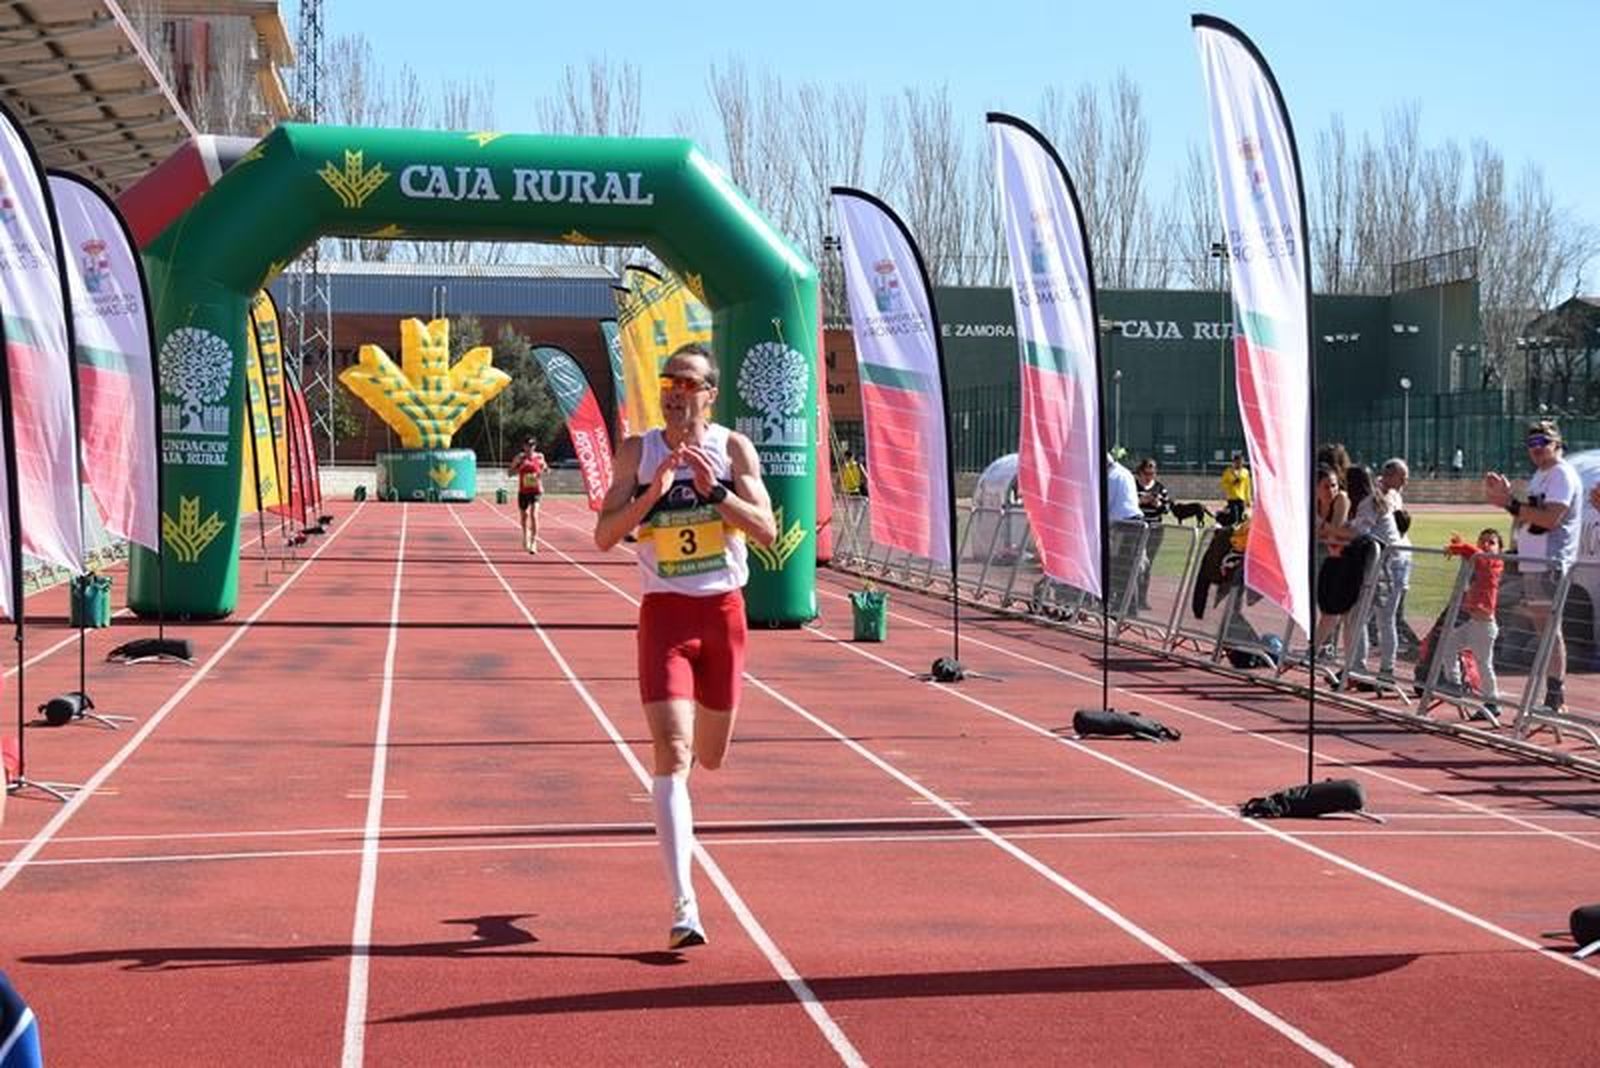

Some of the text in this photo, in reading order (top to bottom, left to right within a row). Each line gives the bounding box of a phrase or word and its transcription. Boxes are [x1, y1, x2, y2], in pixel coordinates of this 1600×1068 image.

[400, 163, 654, 205] CAJA RURAL
[942, 323, 1016, 337] E ZAMORA
[1121, 319, 1234, 340] CAJA RU
[162, 439, 228, 453] UNDACION
[186, 453, 228, 466] RURAL
[680, 528, 698, 556] 3
